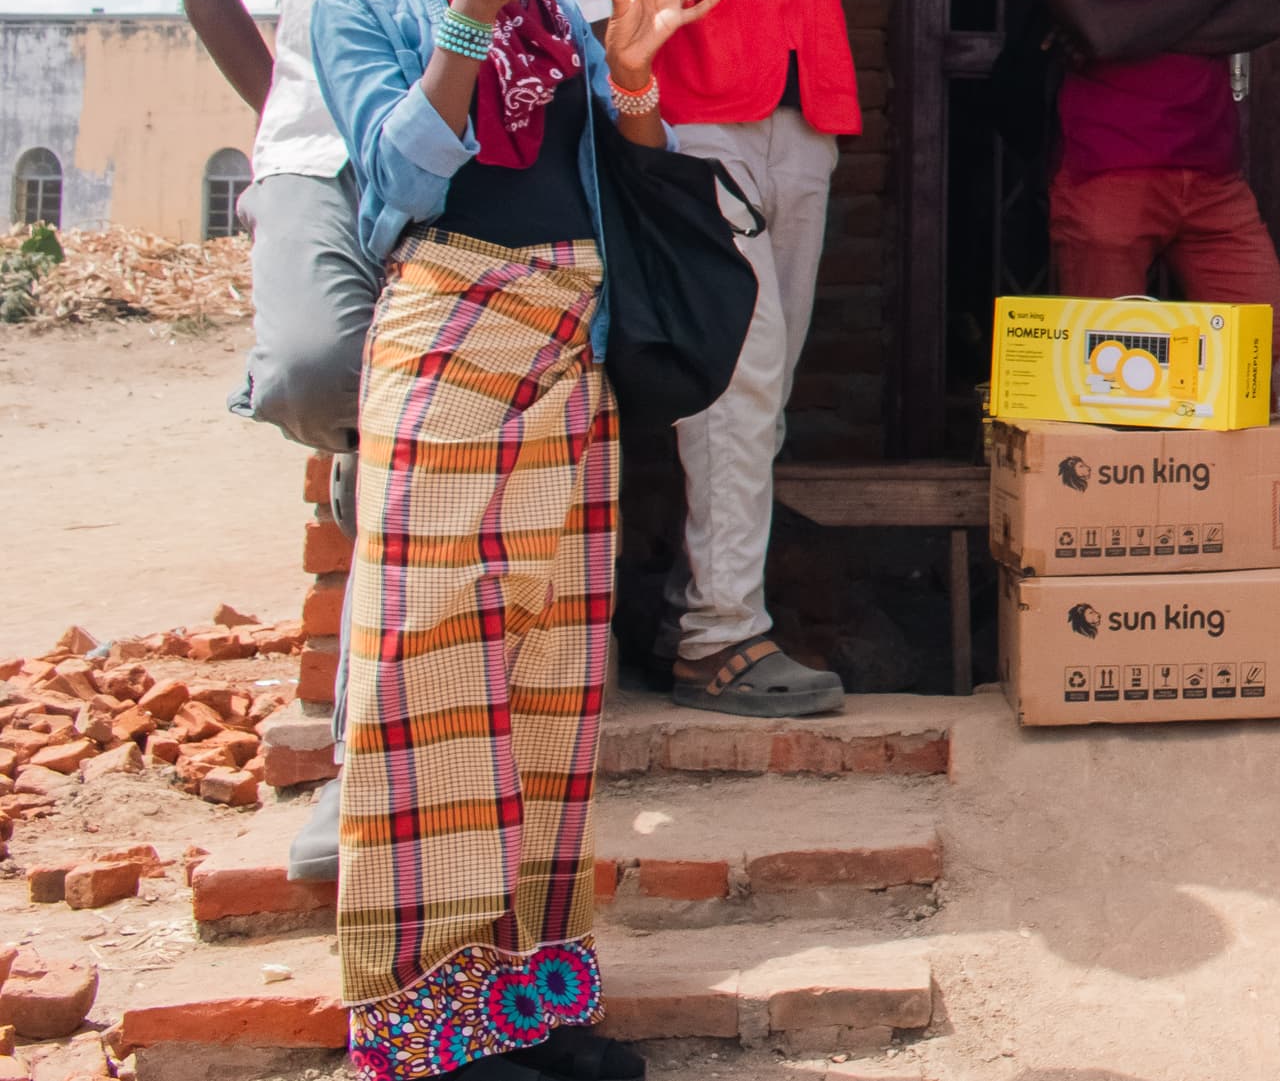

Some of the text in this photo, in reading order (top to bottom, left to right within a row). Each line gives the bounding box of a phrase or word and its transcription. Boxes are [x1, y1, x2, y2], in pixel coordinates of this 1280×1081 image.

[1007, 327, 1069, 340] HOMEPLUS
[1098, 457, 1210, 491] sun king
[1108, 604, 1225, 637] sun king
